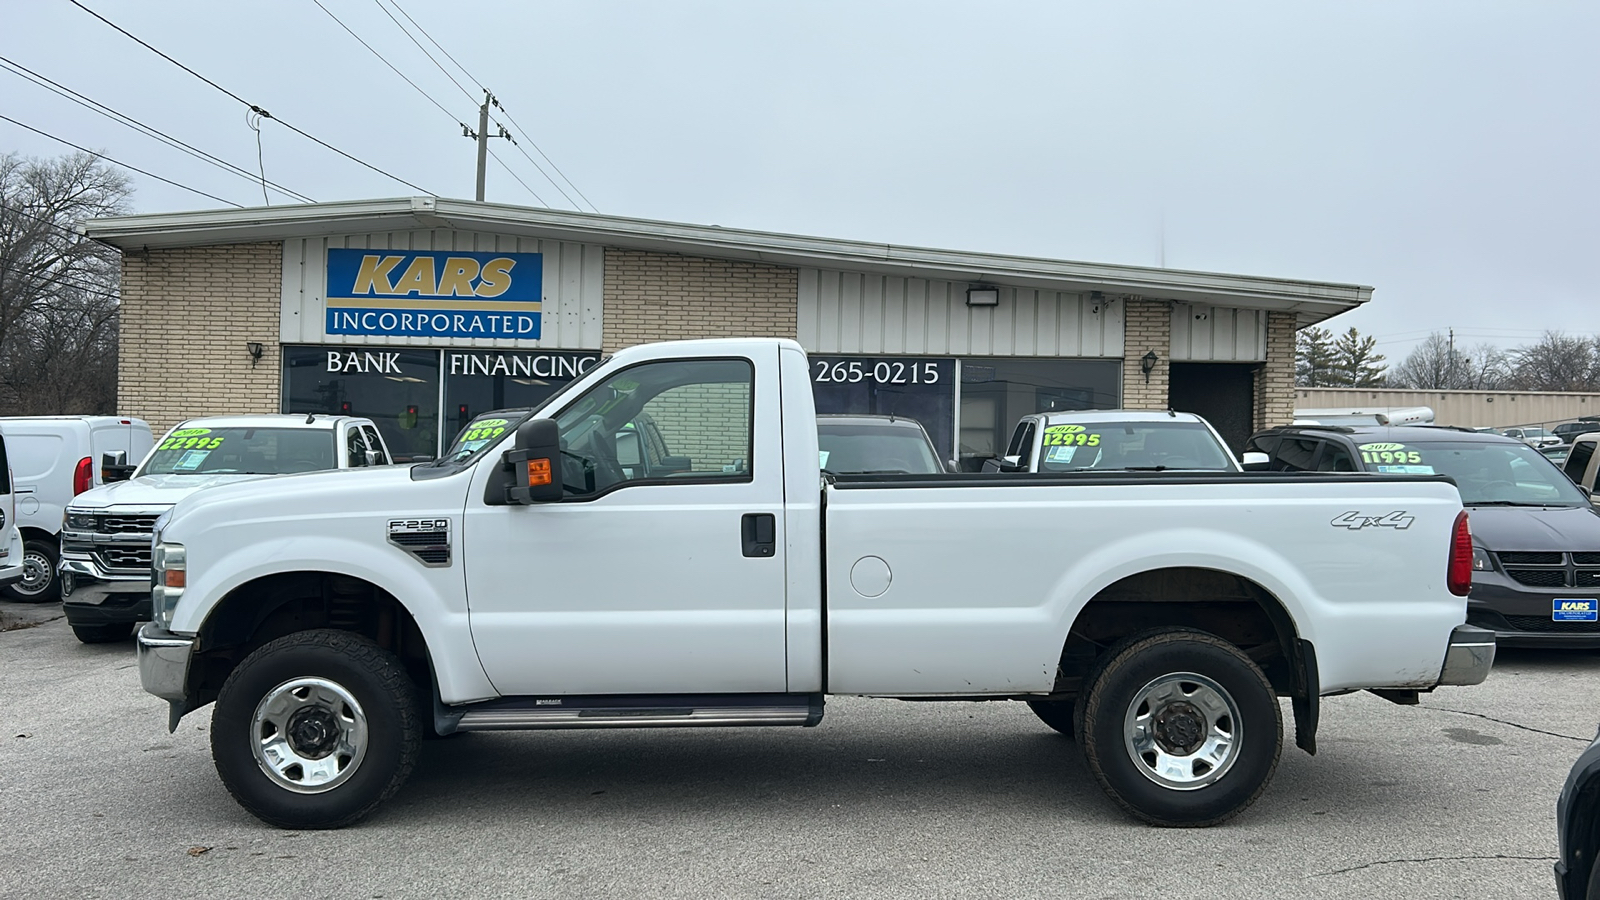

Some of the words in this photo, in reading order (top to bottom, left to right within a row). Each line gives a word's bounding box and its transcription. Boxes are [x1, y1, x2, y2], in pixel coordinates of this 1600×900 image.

[352, 254, 517, 298] KARS
[333, 311, 534, 334] INCORPORATED
[326, 351, 403, 374] BANK
[815, 360, 939, 384] 265-0215
[159, 437, 224, 450] 22995
[1043, 433, 1101, 446] 12995
[1362, 451, 1421, 464] 11995
[389, 519, 448, 530] F-250
[1330, 510, 1415, 530] 4x4
[1561, 602, 1590, 611] KARS
